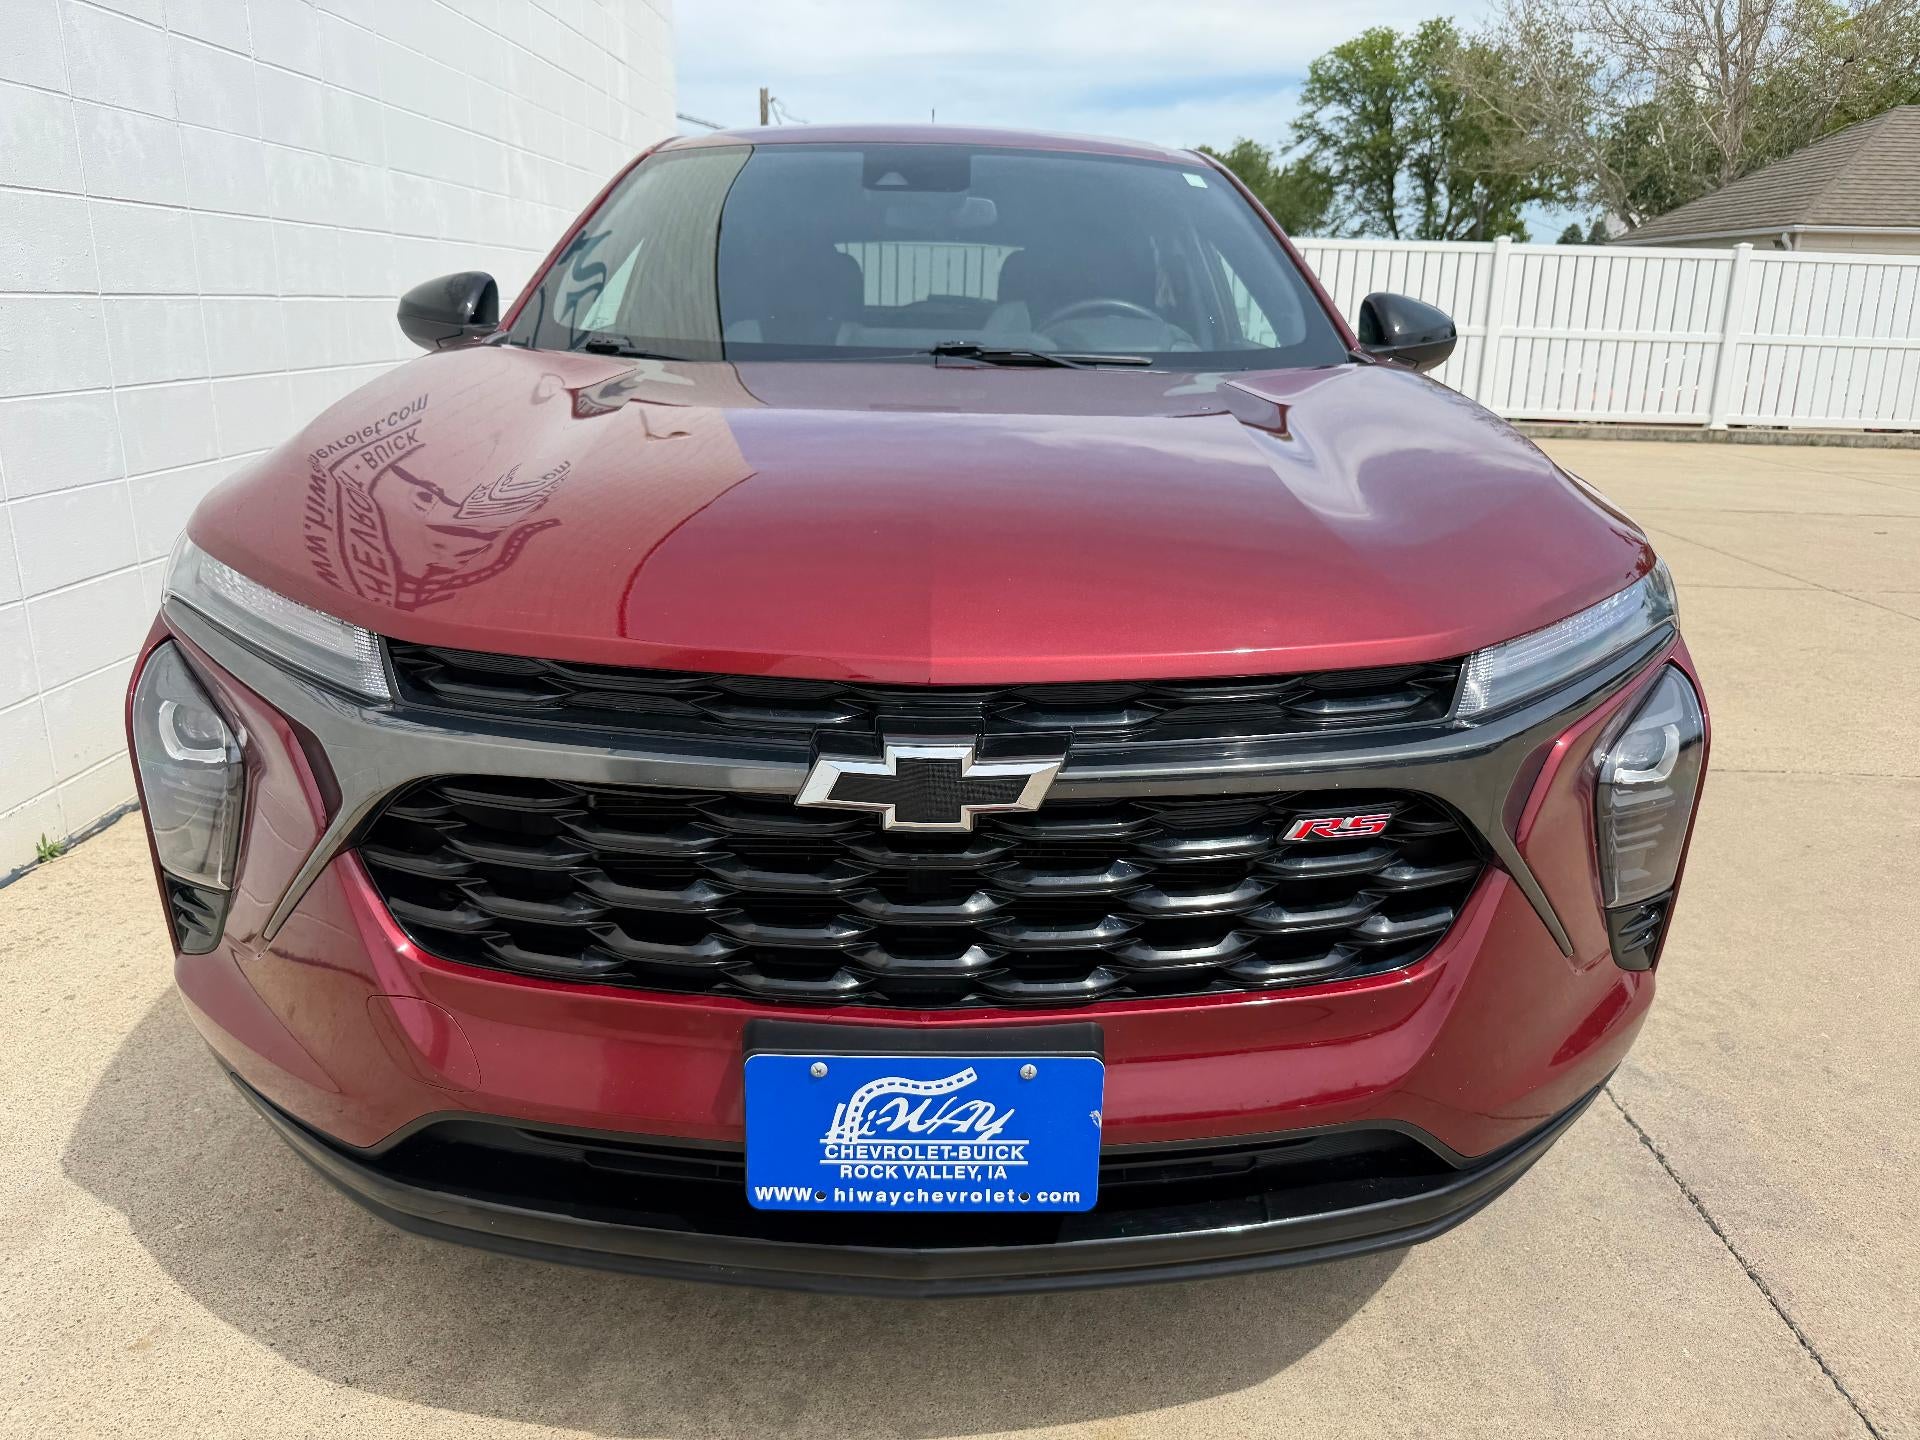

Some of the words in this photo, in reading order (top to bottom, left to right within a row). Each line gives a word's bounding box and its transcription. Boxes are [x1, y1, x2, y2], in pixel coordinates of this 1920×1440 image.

[1282, 812, 1392, 841] RS
[825, 1144, 1025, 1160] CHEVROLET-BUICK
[840, 1164, 899, 1180] ROCK
[903, 1164, 982, 1182] VALLEY,
[987, 1164, 1008, 1180] IA
